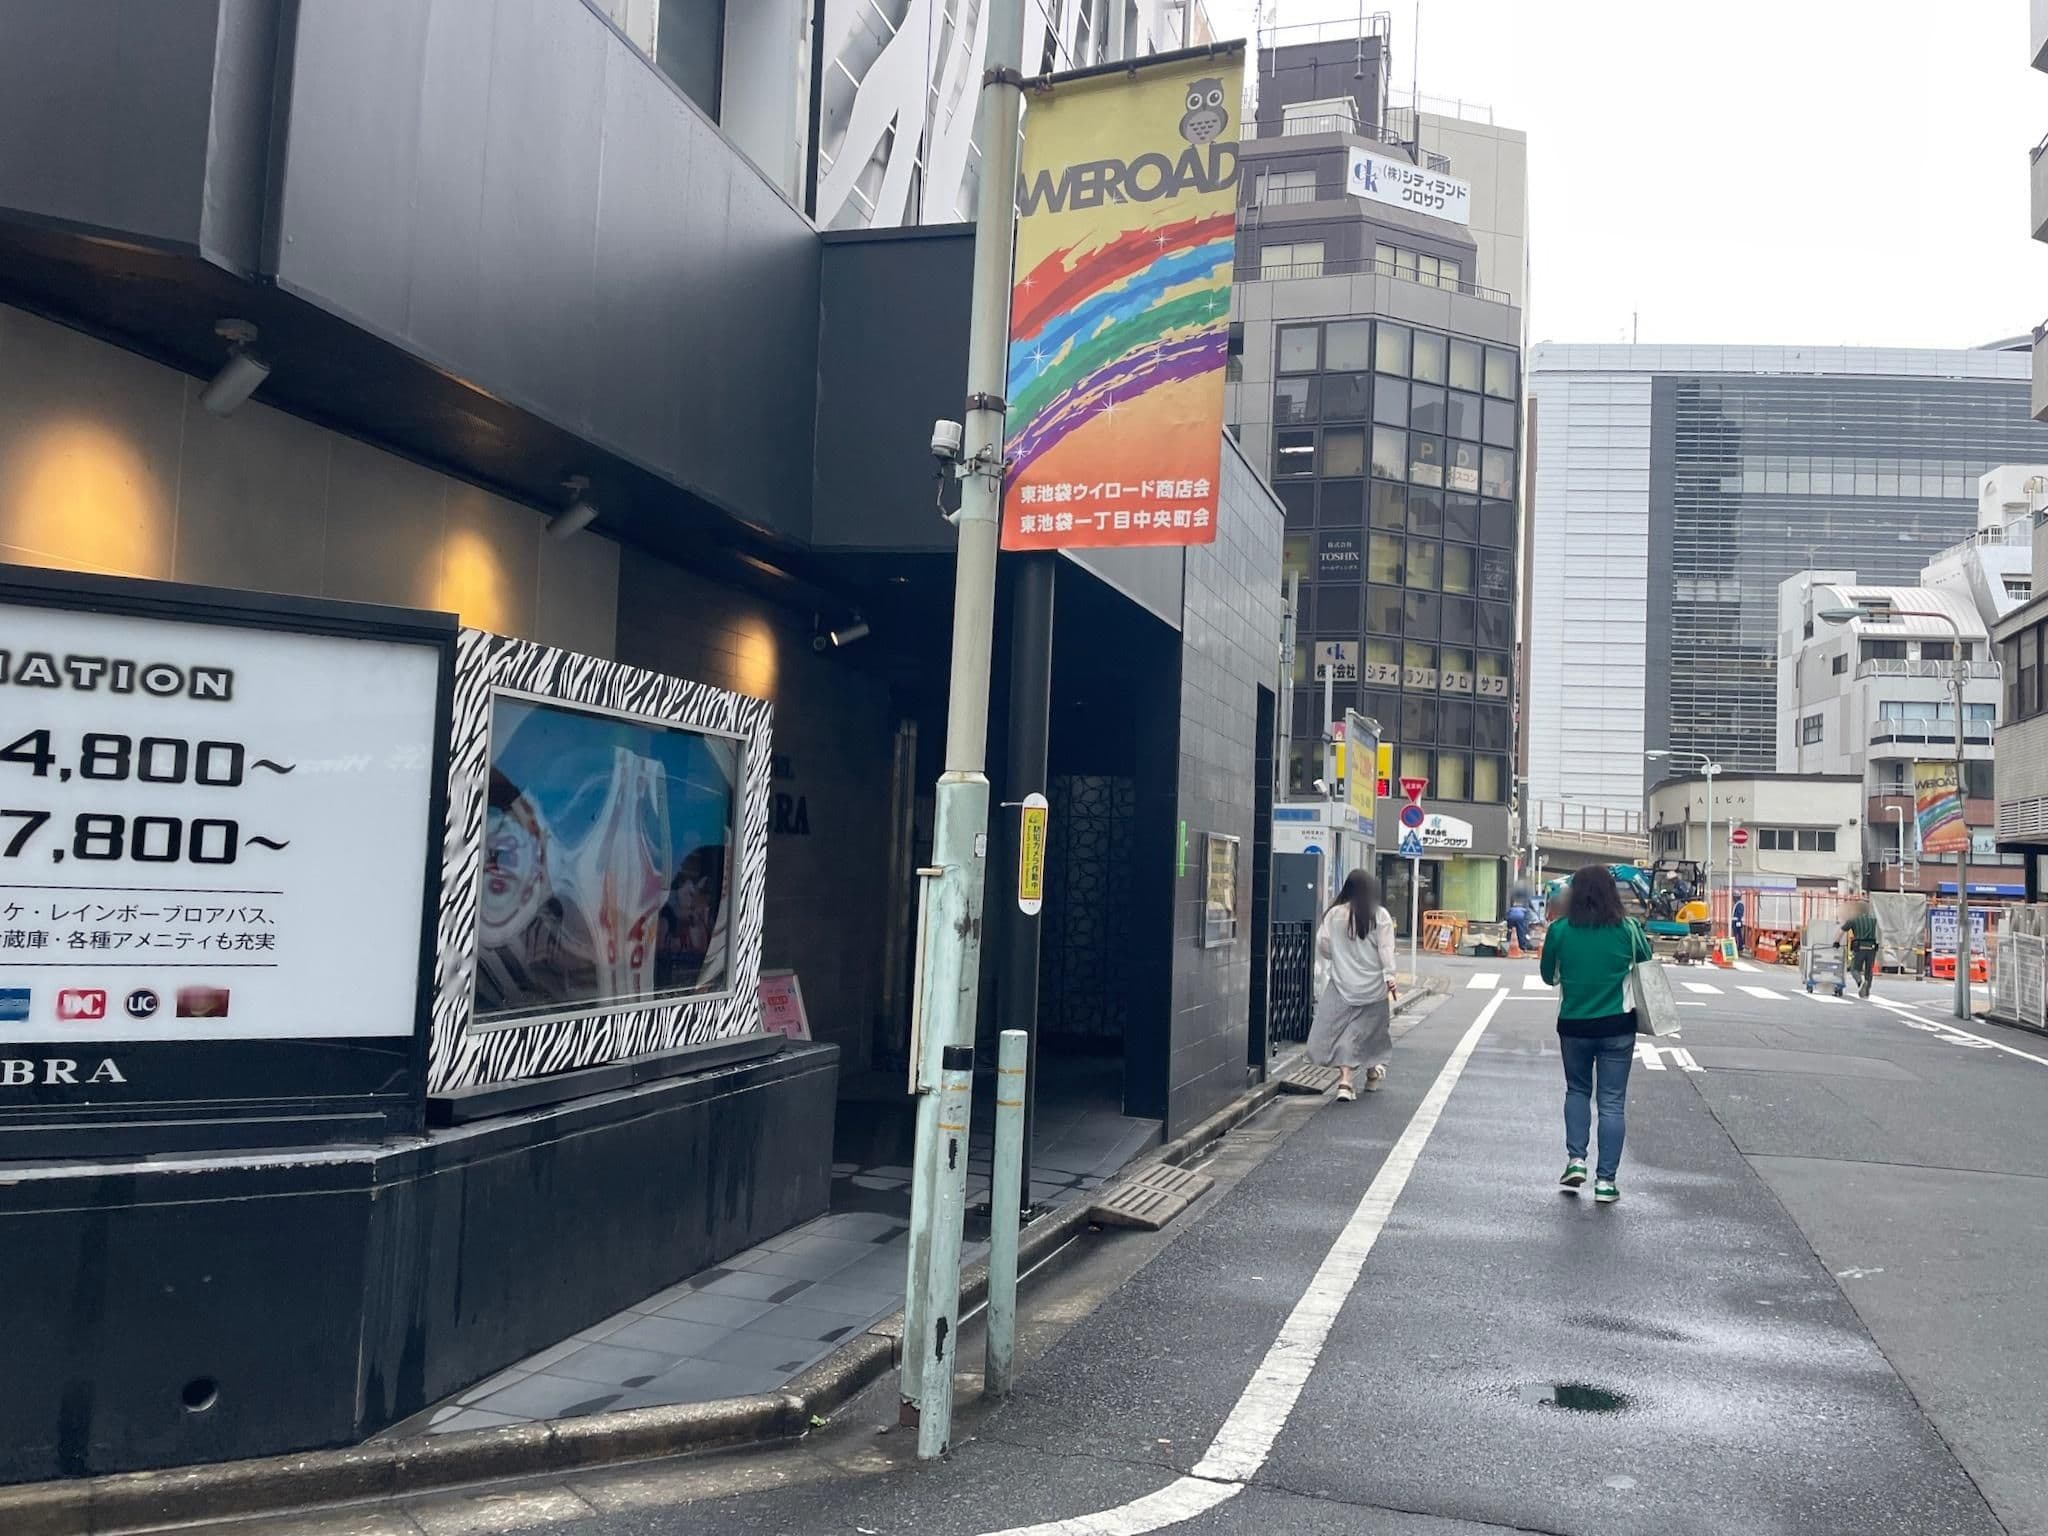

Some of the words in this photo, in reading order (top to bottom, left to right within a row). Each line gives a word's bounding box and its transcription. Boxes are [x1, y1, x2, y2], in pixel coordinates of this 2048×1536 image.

[1383, 164, 1468, 199] (株)シティランド
[1402, 188, 1445, 210] クロサワ
[1020, 478, 1211, 504] 東池袋ウイロード商店会
[1020, 507, 1210, 534] 東池袋一丁目中央町会
[0, 652, 234, 701] ATION
[0, 929, 276, 951] 蔵庫・各種アメニティも充実
[0, 1057, 128, 1086] BRA
